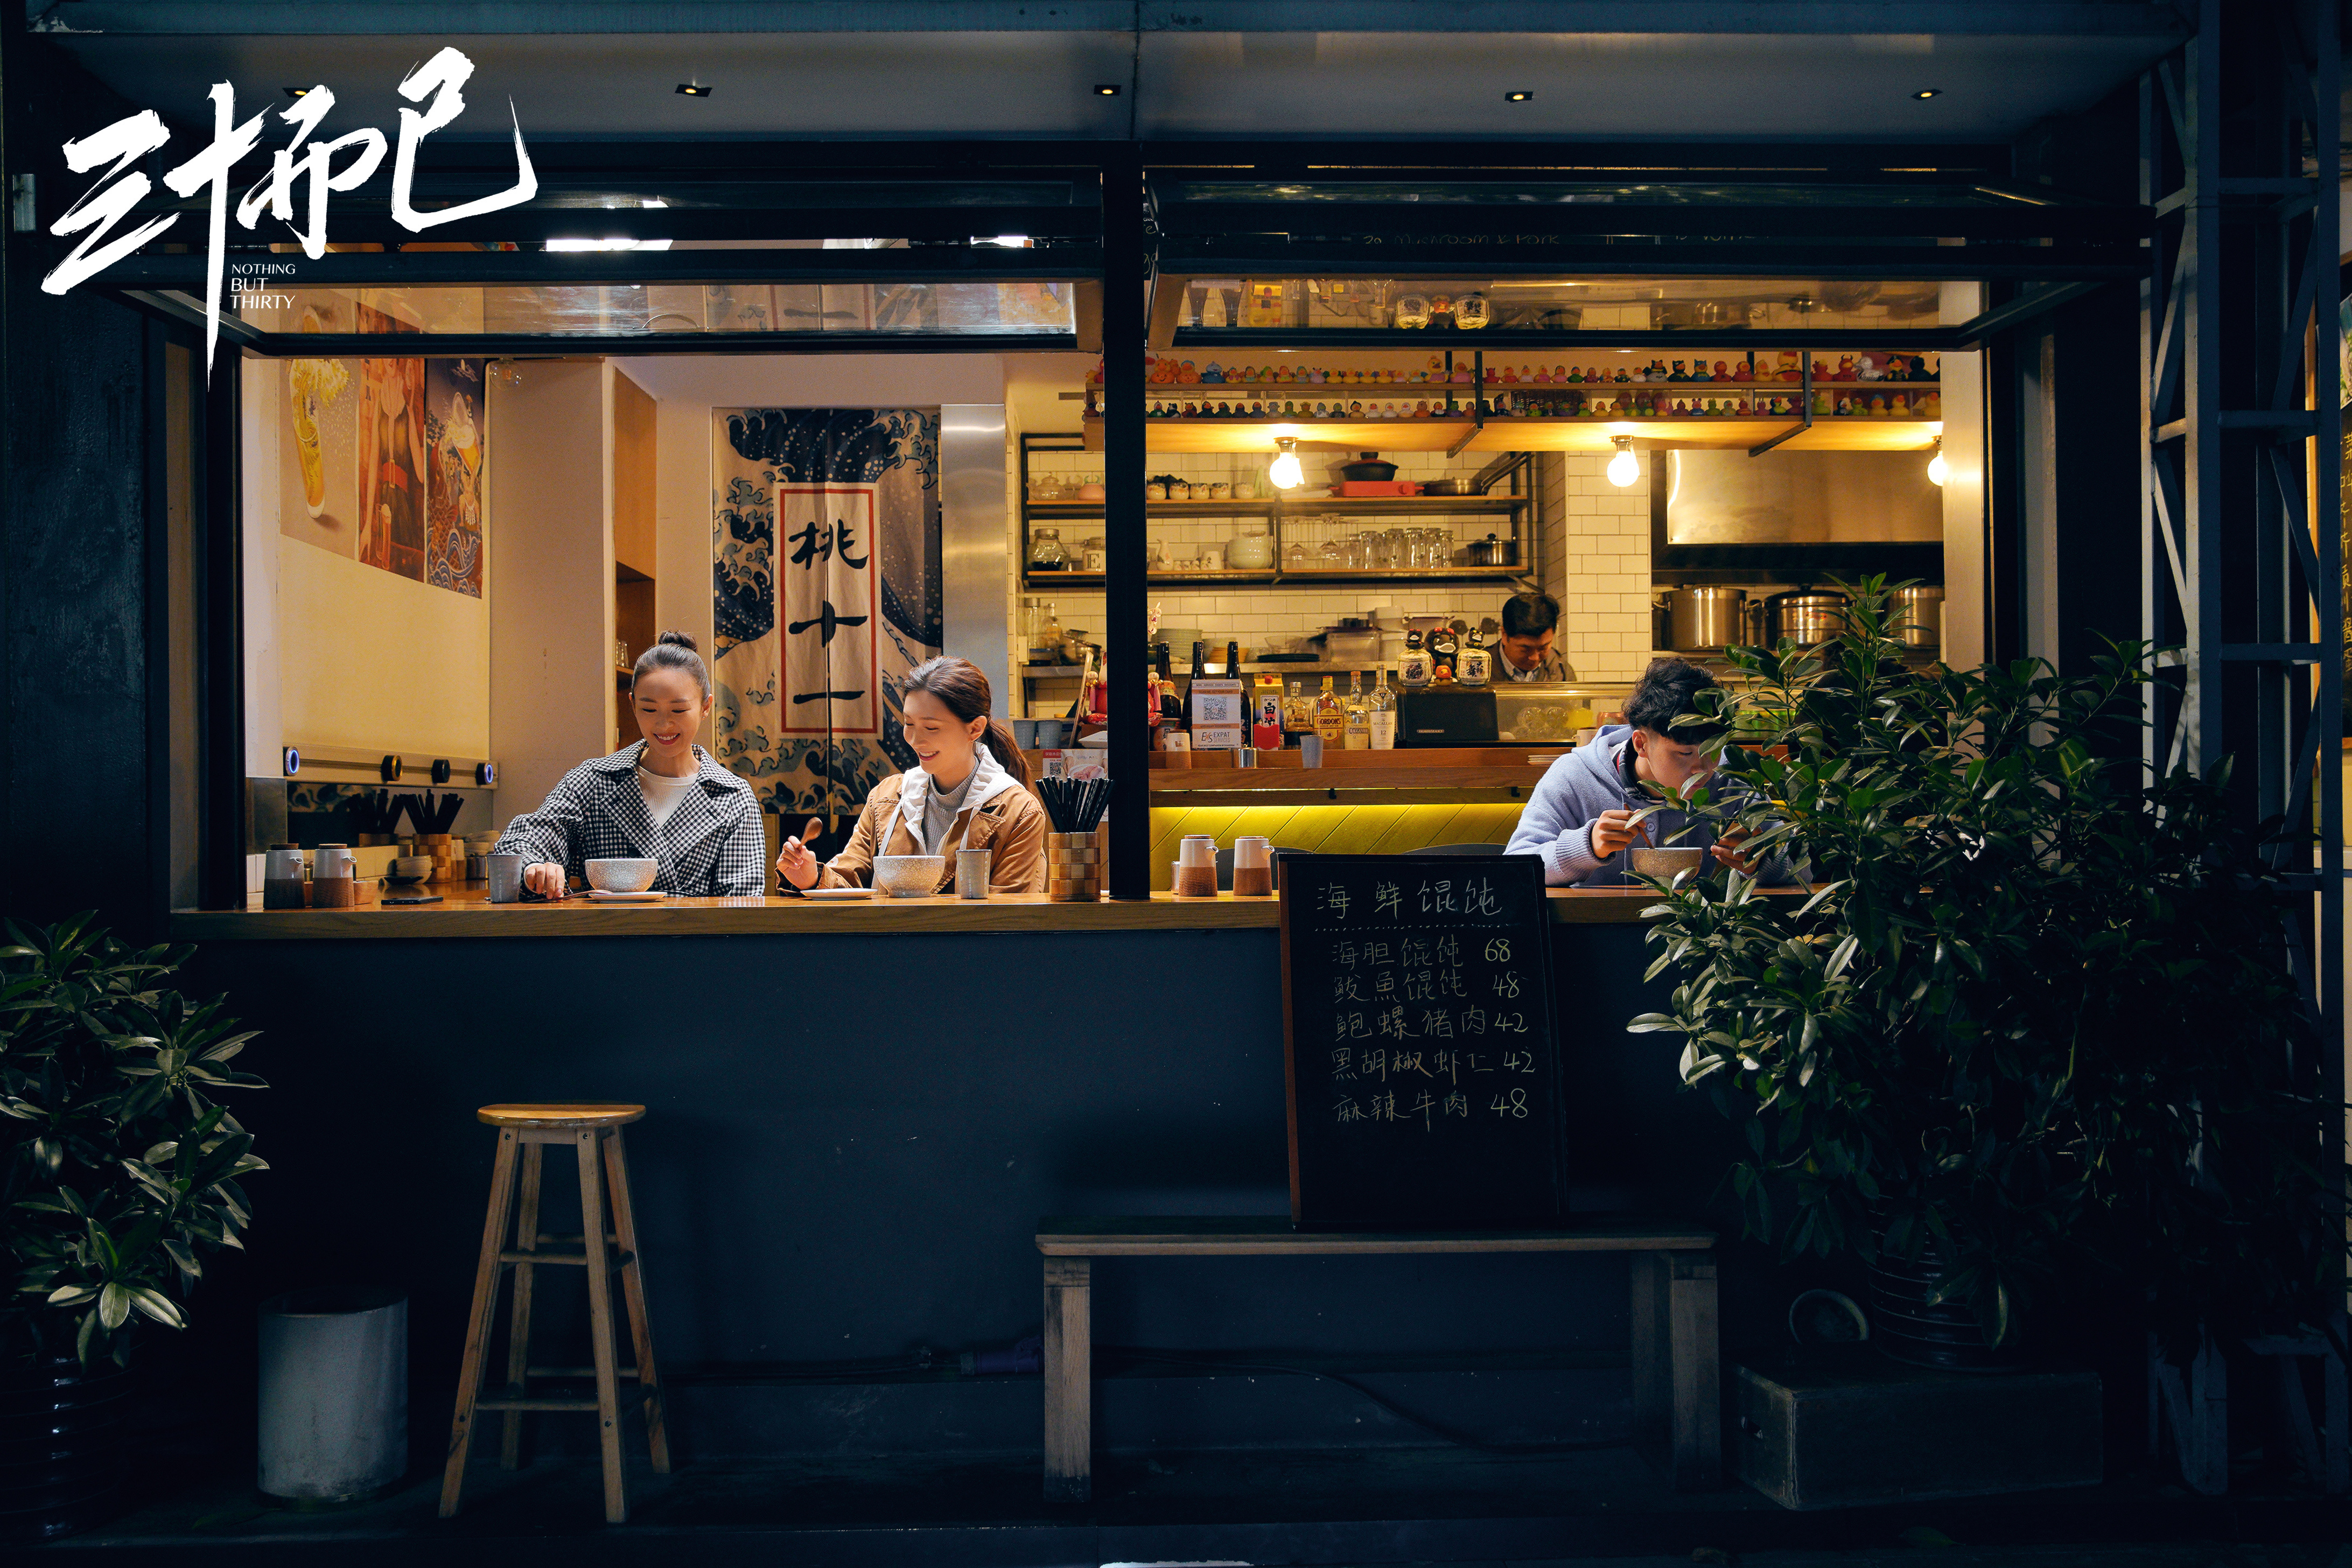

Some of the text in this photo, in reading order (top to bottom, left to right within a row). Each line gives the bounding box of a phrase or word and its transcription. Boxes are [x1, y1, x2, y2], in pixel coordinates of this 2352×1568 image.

[788, 519, 869, 704] 桃十一
[1317, 877, 1503, 920] 海鲜馄饨
[1332, 934, 1511, 970] 海胆馄饨 68
[1492, 971, 1520, 998] 48
[1494, 1013, 1529, 1033] 42
[1331, 1046, 1536, 1086] 黑胡椒虾仁 42
[1332, 1088, 1529, 1132] 麻辣牛肉 48
